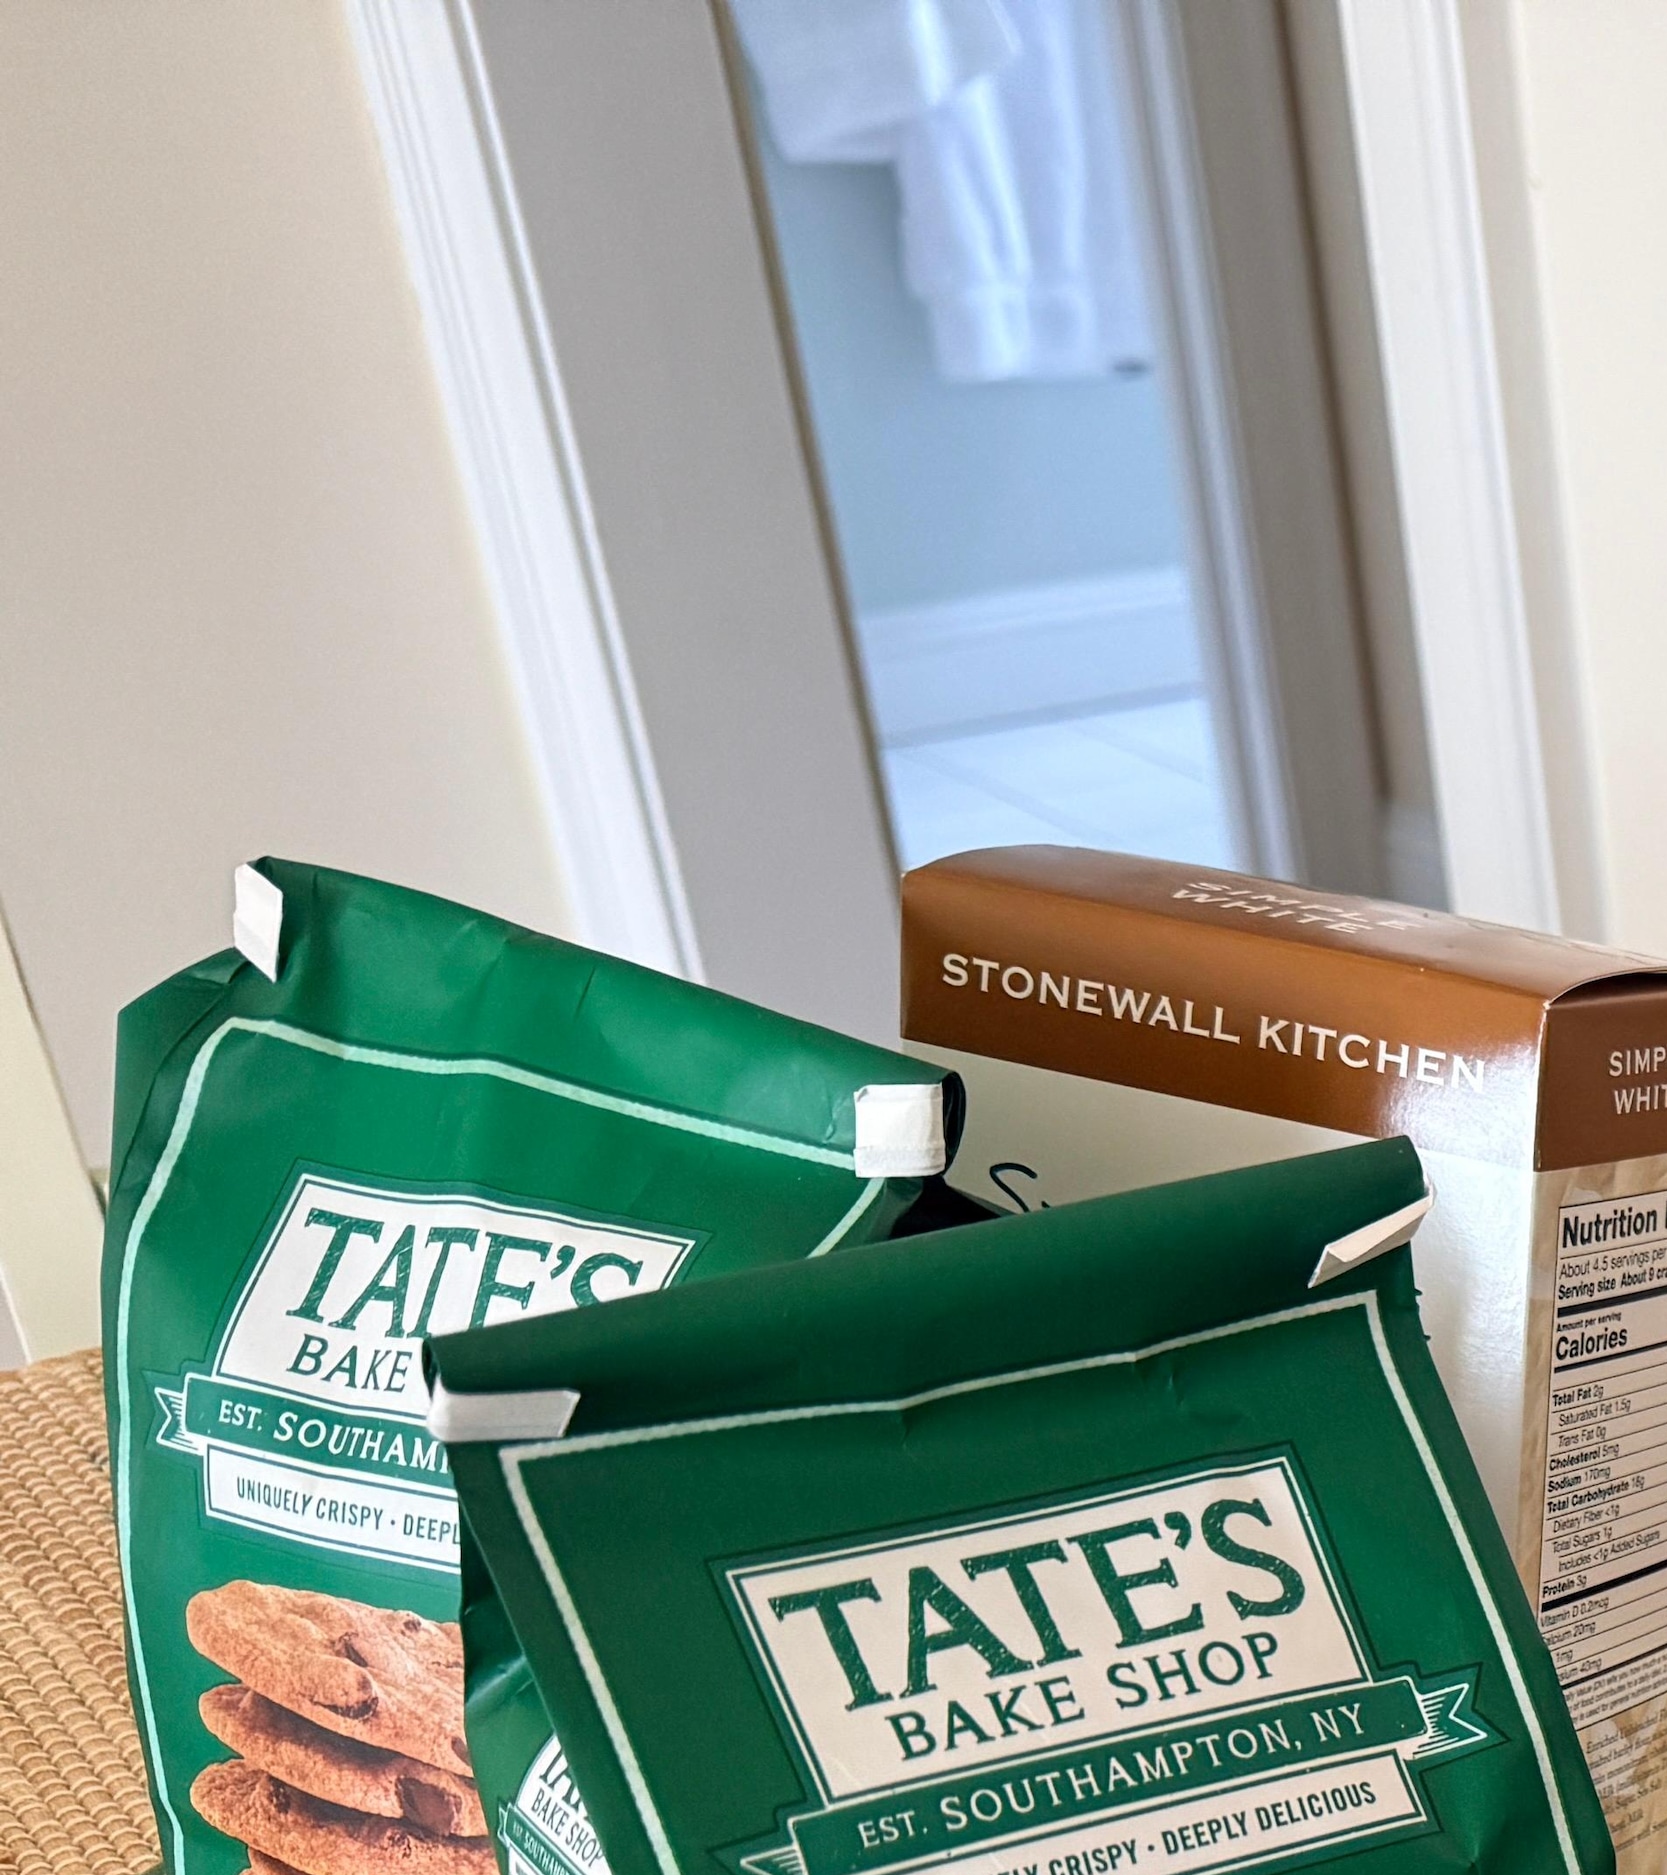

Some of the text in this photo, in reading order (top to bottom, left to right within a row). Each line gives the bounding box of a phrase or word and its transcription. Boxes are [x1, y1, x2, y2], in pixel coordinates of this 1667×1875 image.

[1171, 888, 1373, 935] WHITE
[1186, 881, 1425, 932] SIMPLE
[943, 954, 1486, 1092] STONEWALL KITCHEN
[1562, 1208, 1657, 1248] Nutrition
[1559, 1263, 1590, 1279] About
[1593, 1256, 1608, 1271] 4.5
[1611, 1250, 1650, 1270] servings
[1652, 1247, 1666, 1263] per
[286, 1334, 412, 1392] BAKE
[1556, 1328, 1627, 1360] Calories
[219, 1400, 262, 1431] EST.
[237, 1477, 383, 1530] UNIQUELY CRISPY
[768, 1496, 1305, 1712] TATE'S
[886, 1631, 1280, 1762] BAKE SHOP
[858, 1703, 1363, 1848] EST. SOUTHAMPTON, NY
[531, 1787, 569, 1835] BAKE
[1161, 1817, 1250, 1858] DEEPLY
[1258, 1779, 1377, 1831] DELICIOUS
